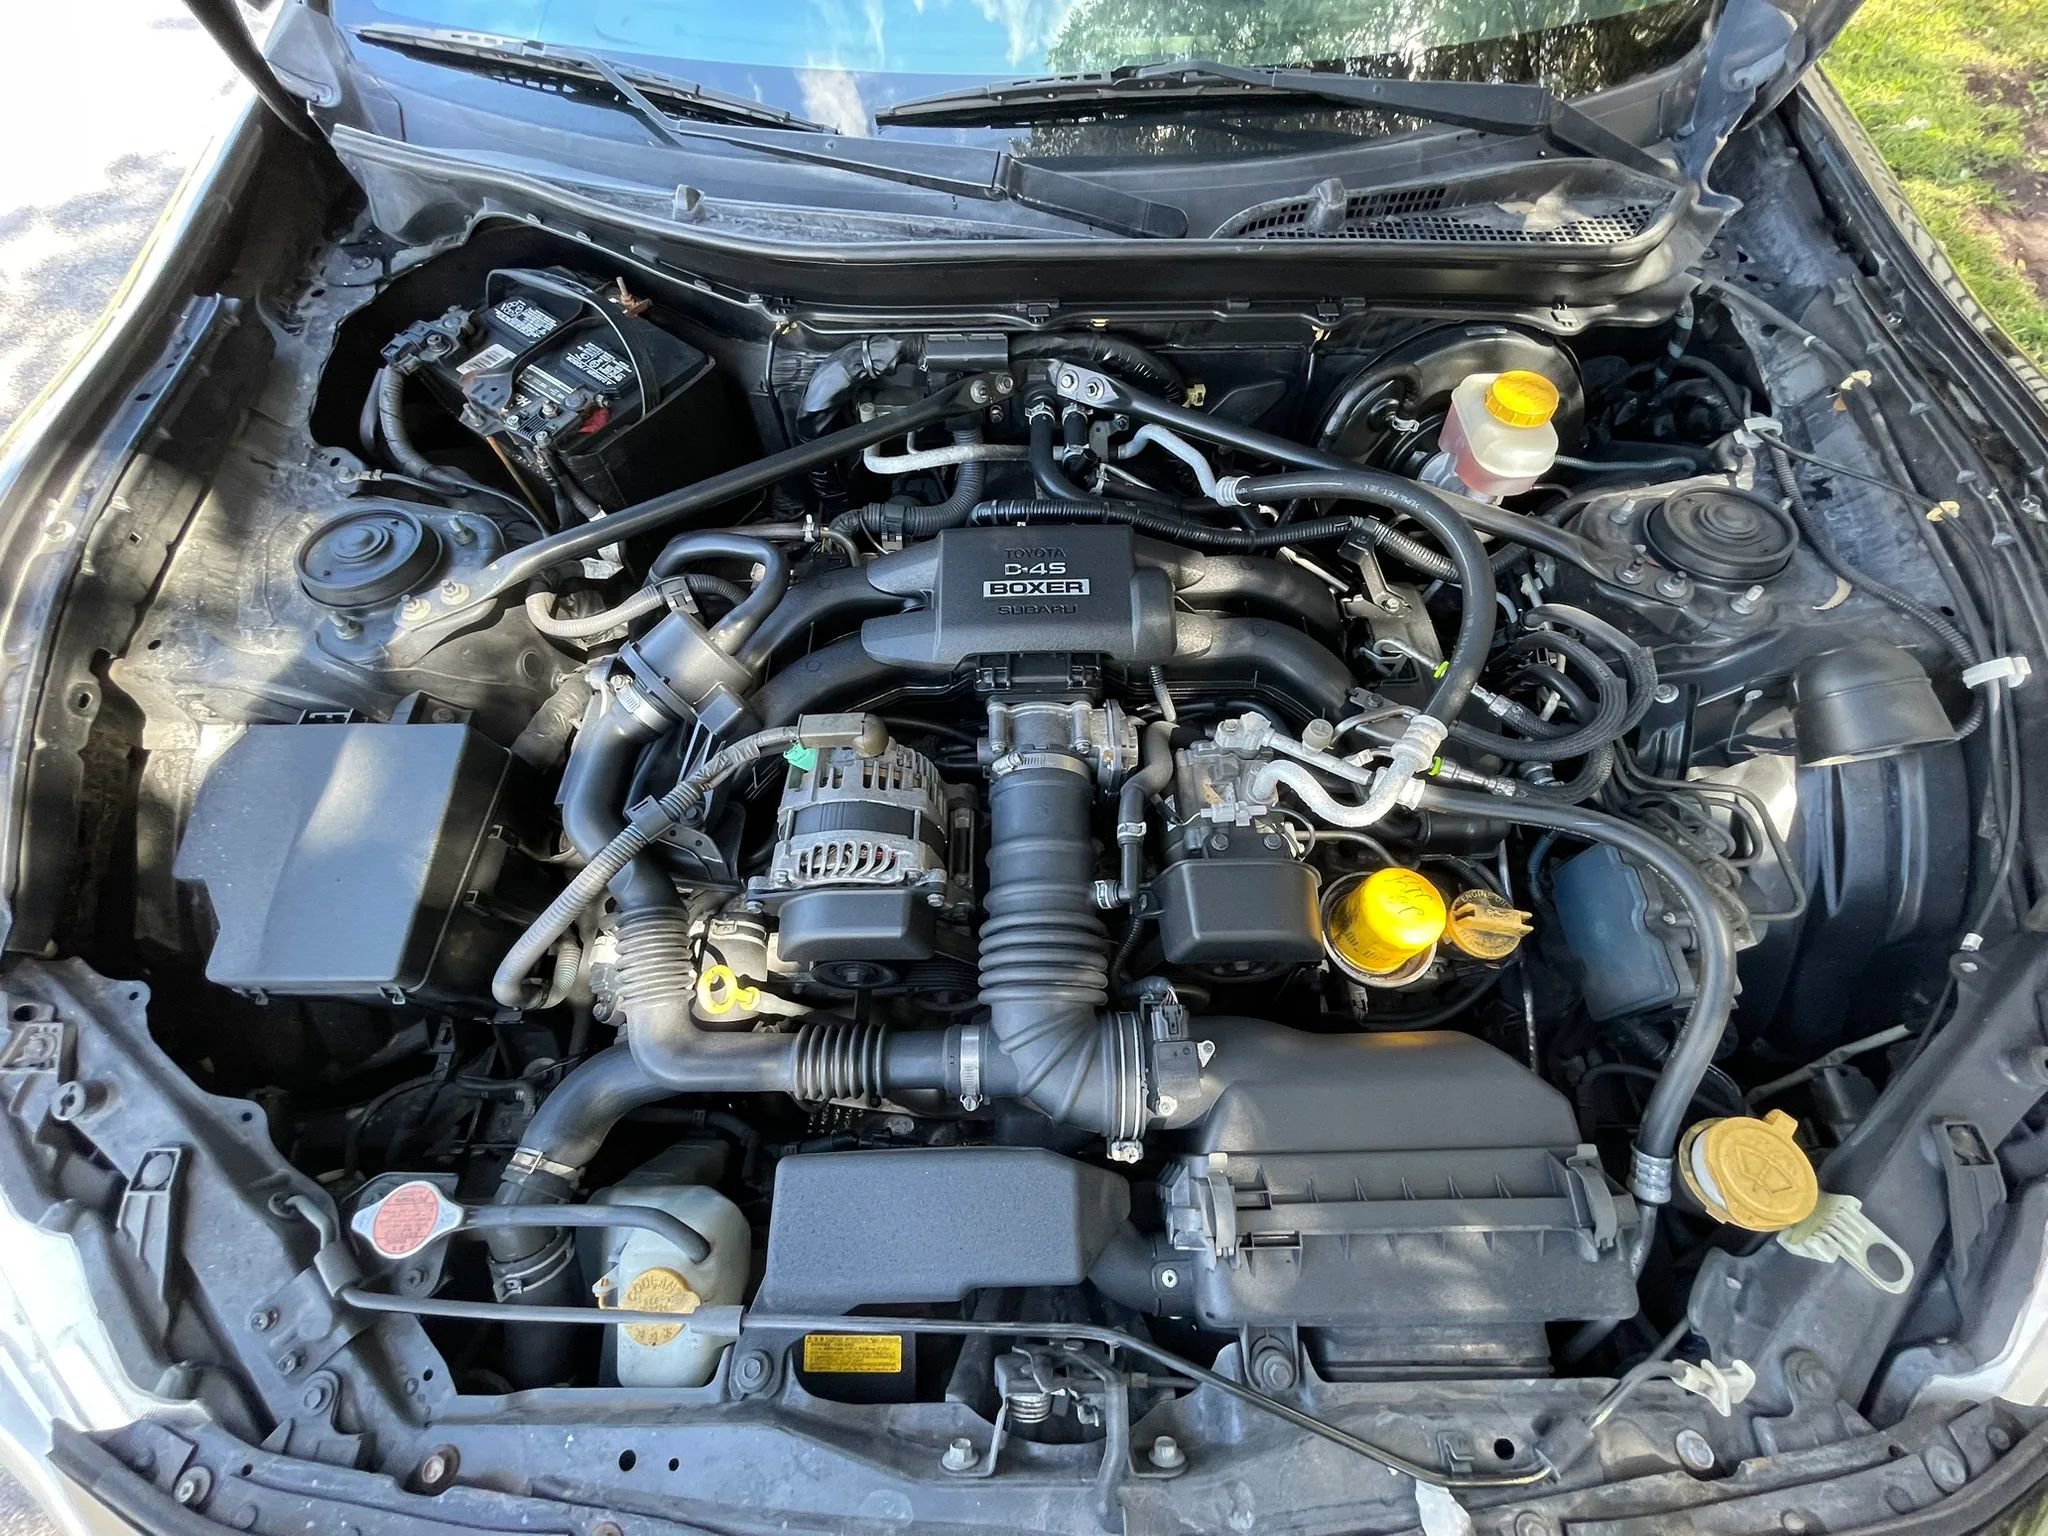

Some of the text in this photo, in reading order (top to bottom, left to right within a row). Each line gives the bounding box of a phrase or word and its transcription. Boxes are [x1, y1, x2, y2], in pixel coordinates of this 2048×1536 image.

[1005, 547, 1066, 559] TOYOTA
[1004, 562, 1067, 575] D-4S
[989, 581, 1084, 595] BOXER
[999, 604, 1077, 616] SUBARU
[1461, 890, 1492, 903] ENGINE
